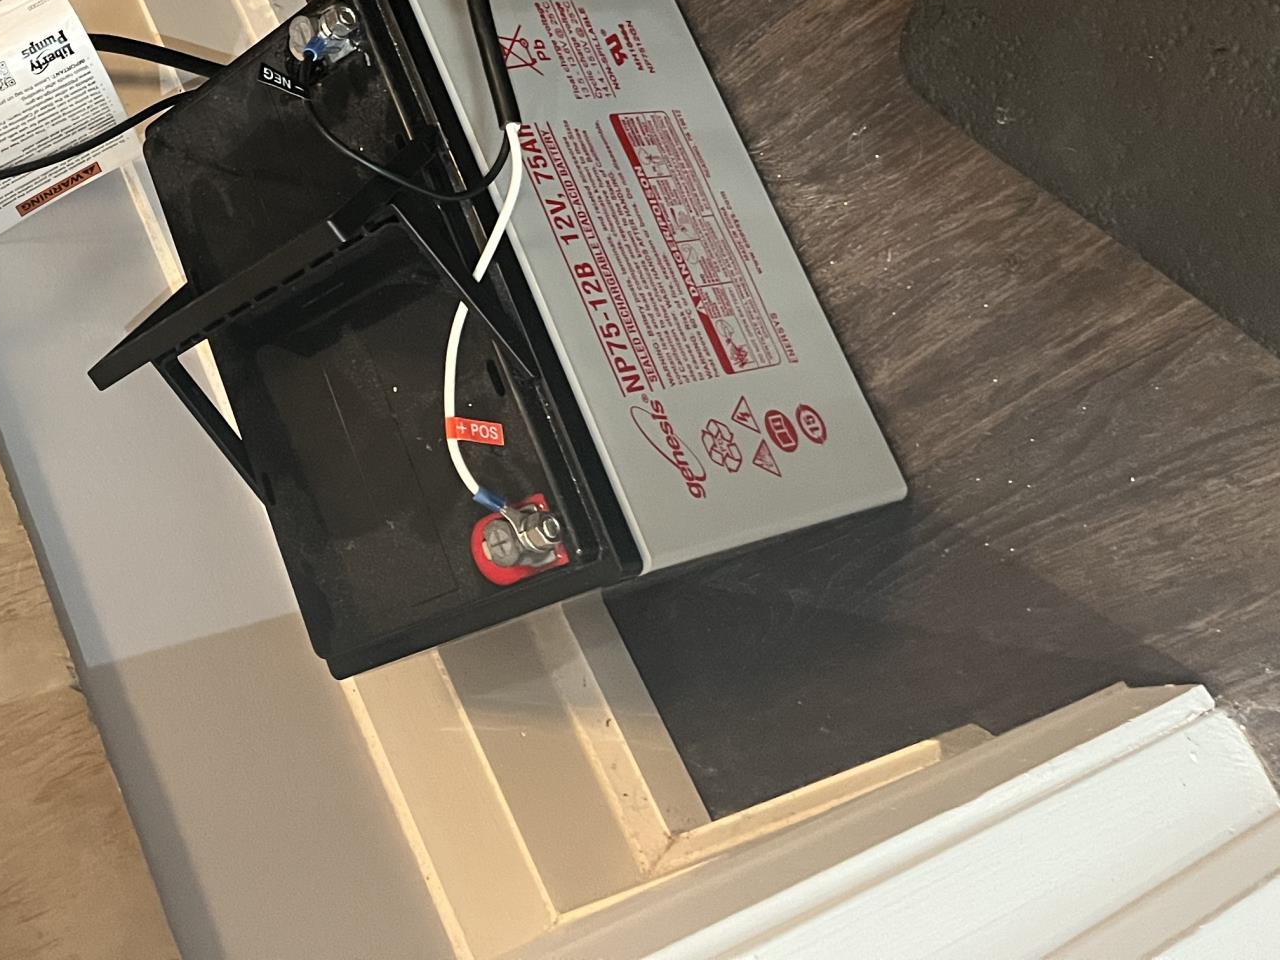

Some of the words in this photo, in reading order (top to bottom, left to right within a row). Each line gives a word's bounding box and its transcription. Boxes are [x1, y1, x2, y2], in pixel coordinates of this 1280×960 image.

[534, 2, 553, 37] voltage
[555, 1, 573, 34] voltage
[21, 29, 68, 63] Pumps
[30, 38, 75, 75] Liberty
[534, 39, 551, 61] Pb
[551, 40, 570, 72] charge
[571, 37, 589, 68] charge
[578, 8, 621, 90] NON-SPILLABLE
[263, 67, 291, 89] NEG
[566, 75, 583, 100] Float
[586, 70, 603, 98] Cyclic
[514, 124, 554, 184] 75Ah
[541, 131, 568, 176] BATTERY
[21, 174, 84, 211] WARNING
[564, 180, 595, 239] LEAD-ACID
[545, 193, 579, 245] 12V,
[634, 166, 699, 297] DANGER/POISON
[592, 246, 636, 333] RECHARGEABLE
[574, 262, 645, 393] NP75-12B
[770, 313, 799, 363] ENERSYS
[632, 338, 657, 382] SEALED
[471, 423, 498, 440] POS
[650, 400, 707, 498] genesis
